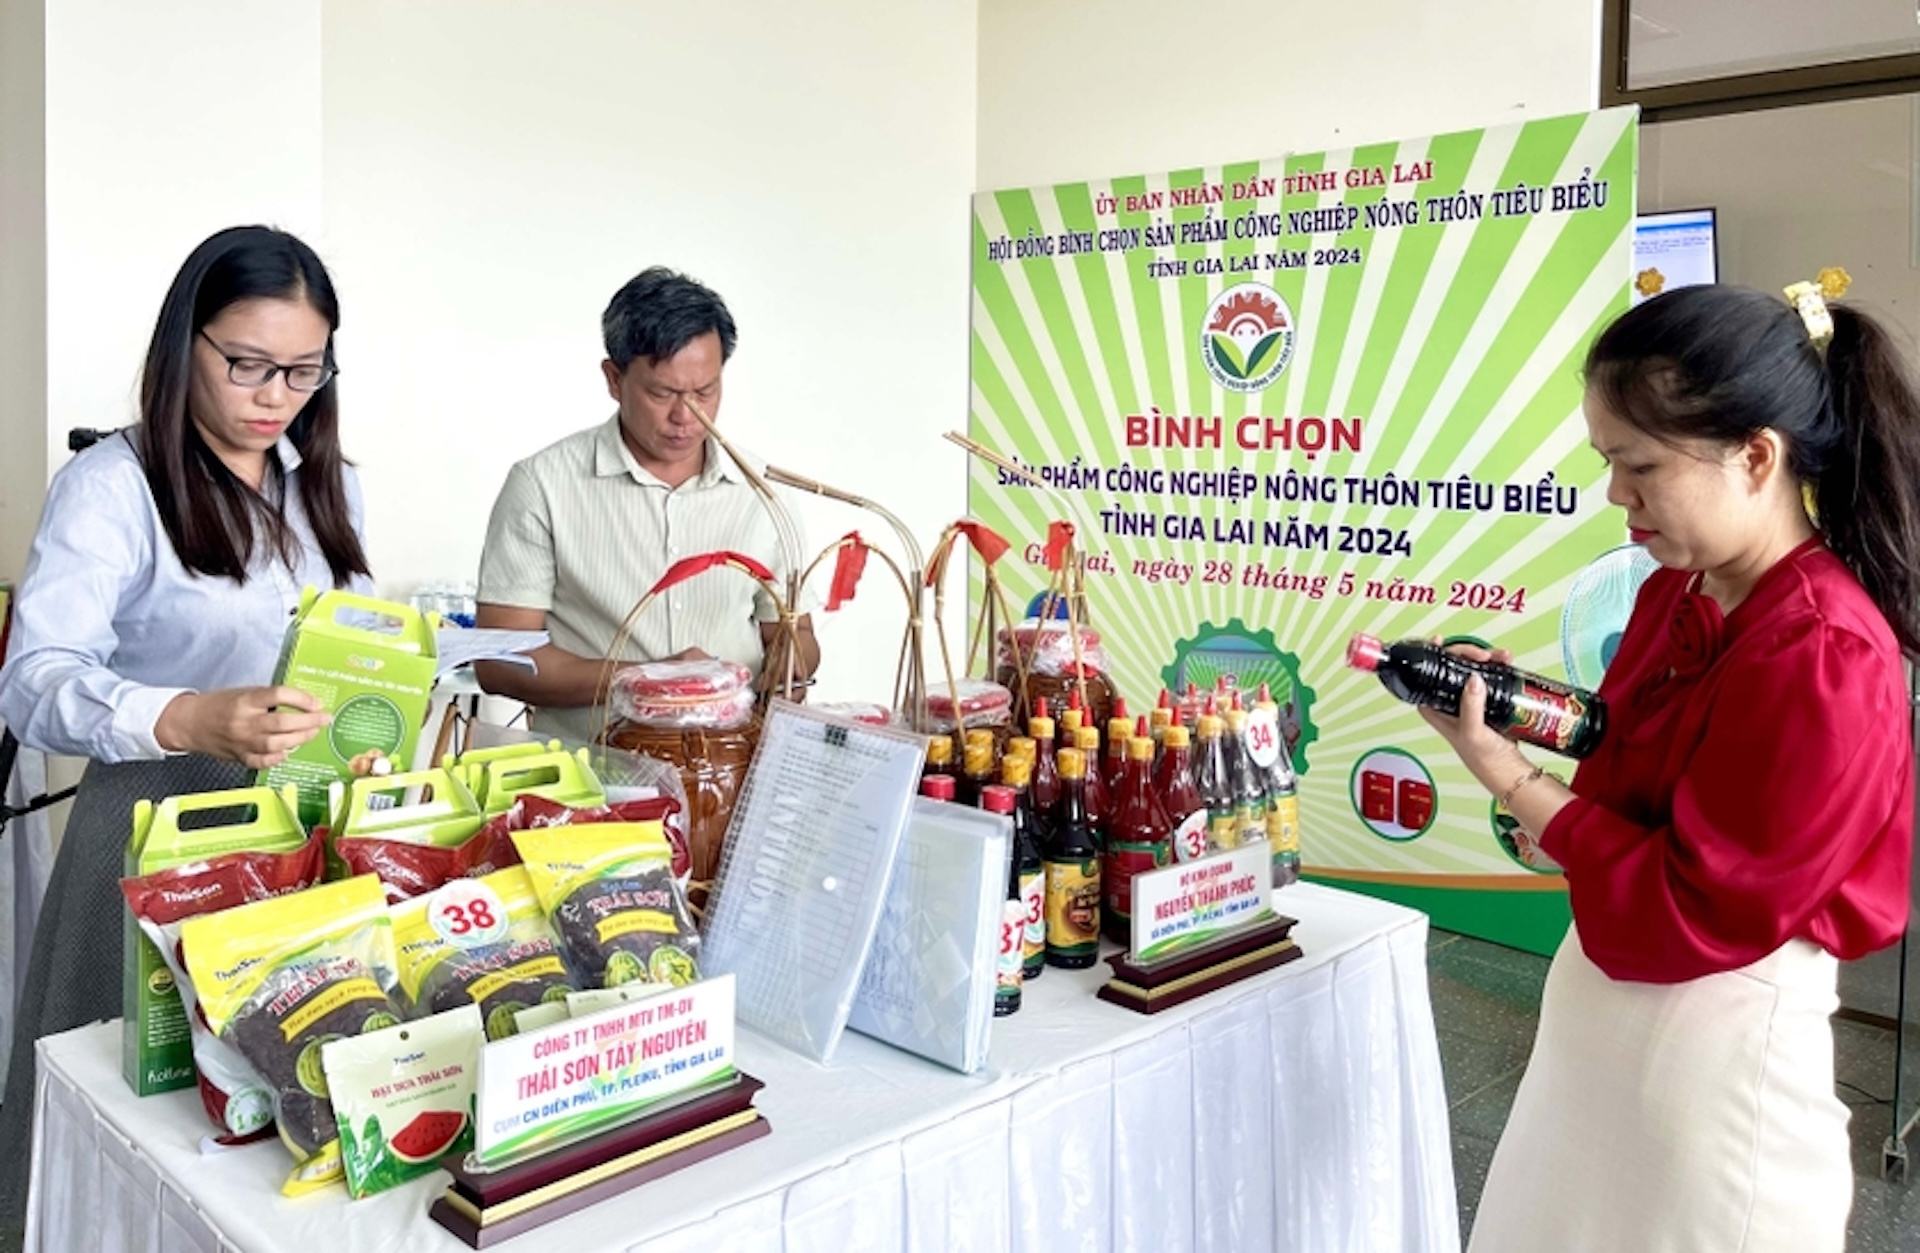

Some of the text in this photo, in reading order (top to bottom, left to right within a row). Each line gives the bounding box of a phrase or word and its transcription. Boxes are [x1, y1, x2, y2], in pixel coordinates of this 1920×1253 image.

[1096, 192, 1119, 215] ỦY
[1126, 192, 1163, 212] BAN
[1169, 182, 1224, 208] NHÂN
[1232, 176, 1276, 200] DÂN
[1345, 167, 1385, 188] GIA
[1394, 161, 1434, 184] LAI
[988, 167, 1608, 263] HỘI ĐỒNG BÌNH CHỌN SẢN PHẨM CÔNG NGHIỆP NÔNG THÔN TIÊU BIỂU
[1147, 247, 1361, 278] TỈNH GIA LAI NĂM 2024
[1126, 407, 1362, 460] BÌNH CHỌN
[1041, 455, 1100, 490] PHẨM
[1105, 463, 1164, 494] CÔNG
[1170, 466, 1257, 504] NGHIỆP
[1265, 468, 1337, 503] NÔNG
[1344, 472, 1420, 508] THÔN
[1427, 474, 1493, 511] TIÊU
[1503, 471, 1577, 515] BIỂU
[1100, 503, 1411, 557] TỈNH GIA LAI NĂM 2024
[1132, 556, 1194, 585] ngày
[1202, 560, 1233, 584] 28
[1241, 562, 1328, 599] tháng
[1337, 572, 1356, 597] 5
[1365, 577, 1437, 605] năm
[1447, 581, 1526, 614] 2024
[1250, 724, 1272, 750] 34
[1186, 825, 1207, 859] 3
[442, 899, 496, 936] 38
[1027, 894, 1046, 924] 3
[1000, 919, 1024, 954] 37
[516, 1018, 707, 1101] THÁI SƠN TÂY NGUYÊN
[534, 1033, 570, 1059] CÔNG
[574, 1028, 588, 1046] TY
[593, 1017, 625, 1041] TNHH
[629, 1008, 654, 1030] MTV
[523, 1107, 540, 1124] CN
[690, 1052, 705, 1067] GIA
[708, 1046, 724, 1061] LAI
